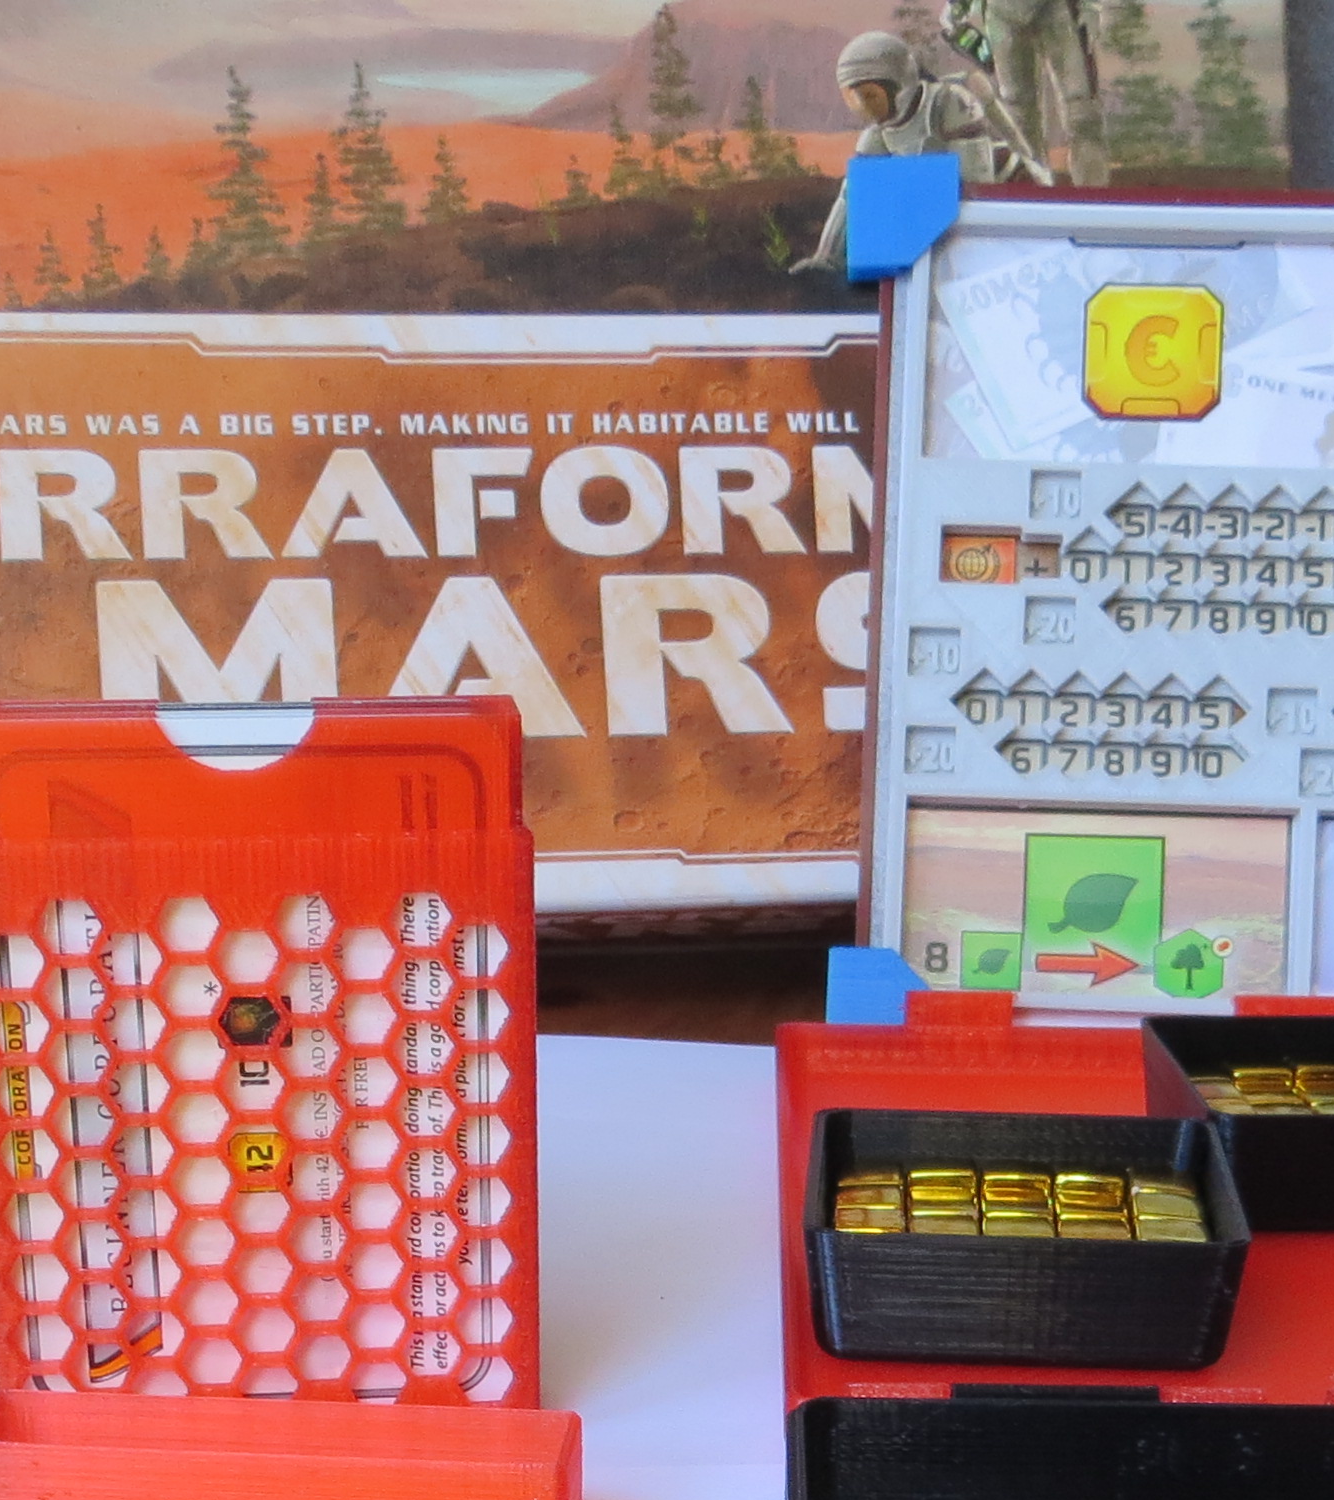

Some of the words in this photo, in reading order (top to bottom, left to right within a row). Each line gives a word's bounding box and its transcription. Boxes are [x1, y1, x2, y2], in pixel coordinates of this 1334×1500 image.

[84, 413, 161, 436] WAS
[177, 413, 201, 436] A
[218, 413, 274, 436] BIG
[290, 414, 383, 436] STEP.
[399, 412, 529, 435] MAKING
[545, 412, 574, 435] IT
[591, 411, 768, 434] HABITABLE
[785, 411, 861, 434] WILL
[1158, 511, 1194, 540] -4
[1205, 513, 1241, 541] -3
[1252, 514, 1286, 541] -2
[1305, 516, 1326, 542] -1
[400, 897, 415, 944] There
[925, 942, 948, 973] 8
[430, 1048, 441, 1057] a
[405, 1088, 422, 1133] doing
[428, 1114, 443, 1134] of.
[316, 1157, 329, 1173] 42
[316, 1178, 330, 1204] ith
[433, 1222, 445, 1236] to
[435, 1300, 446, 1316] or
[410, 1340, 424, 1368] This
